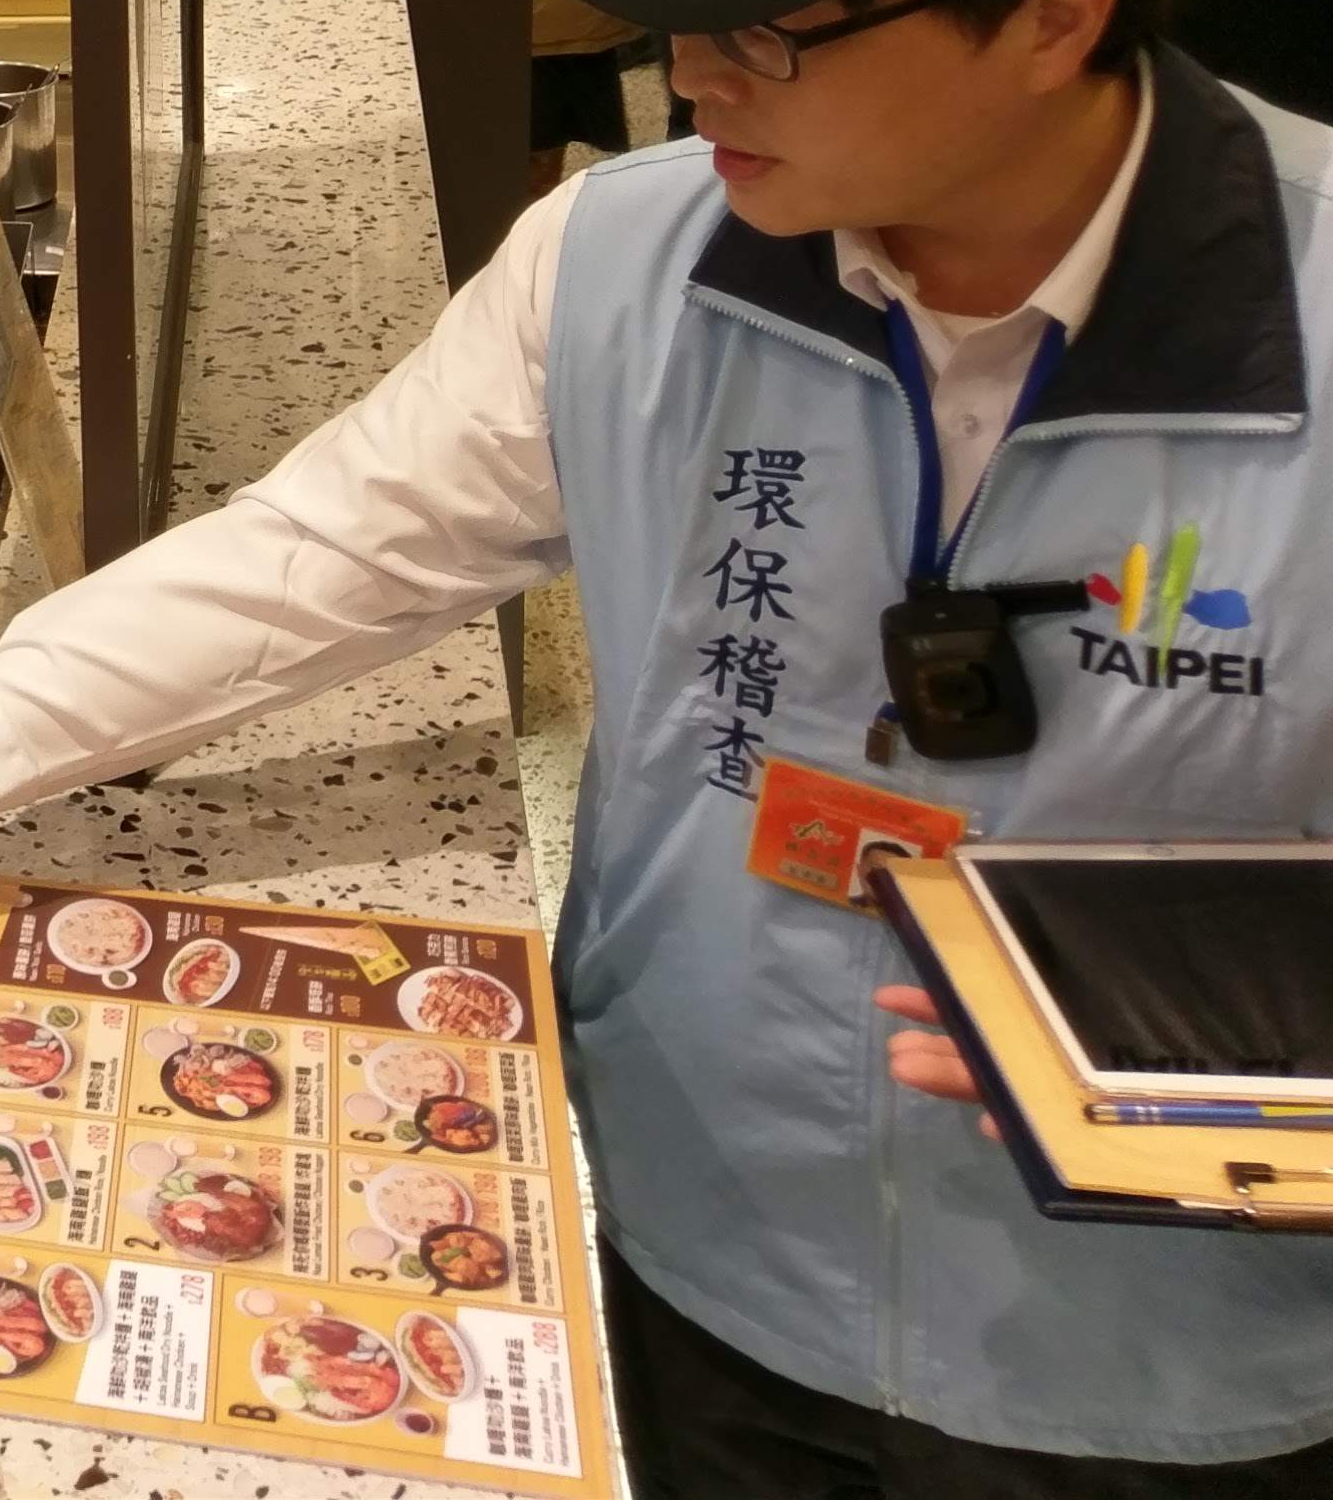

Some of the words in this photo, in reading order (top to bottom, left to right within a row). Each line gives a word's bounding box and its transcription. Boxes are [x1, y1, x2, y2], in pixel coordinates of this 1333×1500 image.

[696, 446, 806, 803] 環保稽查
[1069, 626, 1265, 697] TAIPEI
[138, 1105, 173, 1117] 5
[350, 1129, 386, 1143] 6
[124, 1237, 161, 1251] 2
[350, 1267, 389, 1281] 3
[228, 1403, 277, 1424] B
